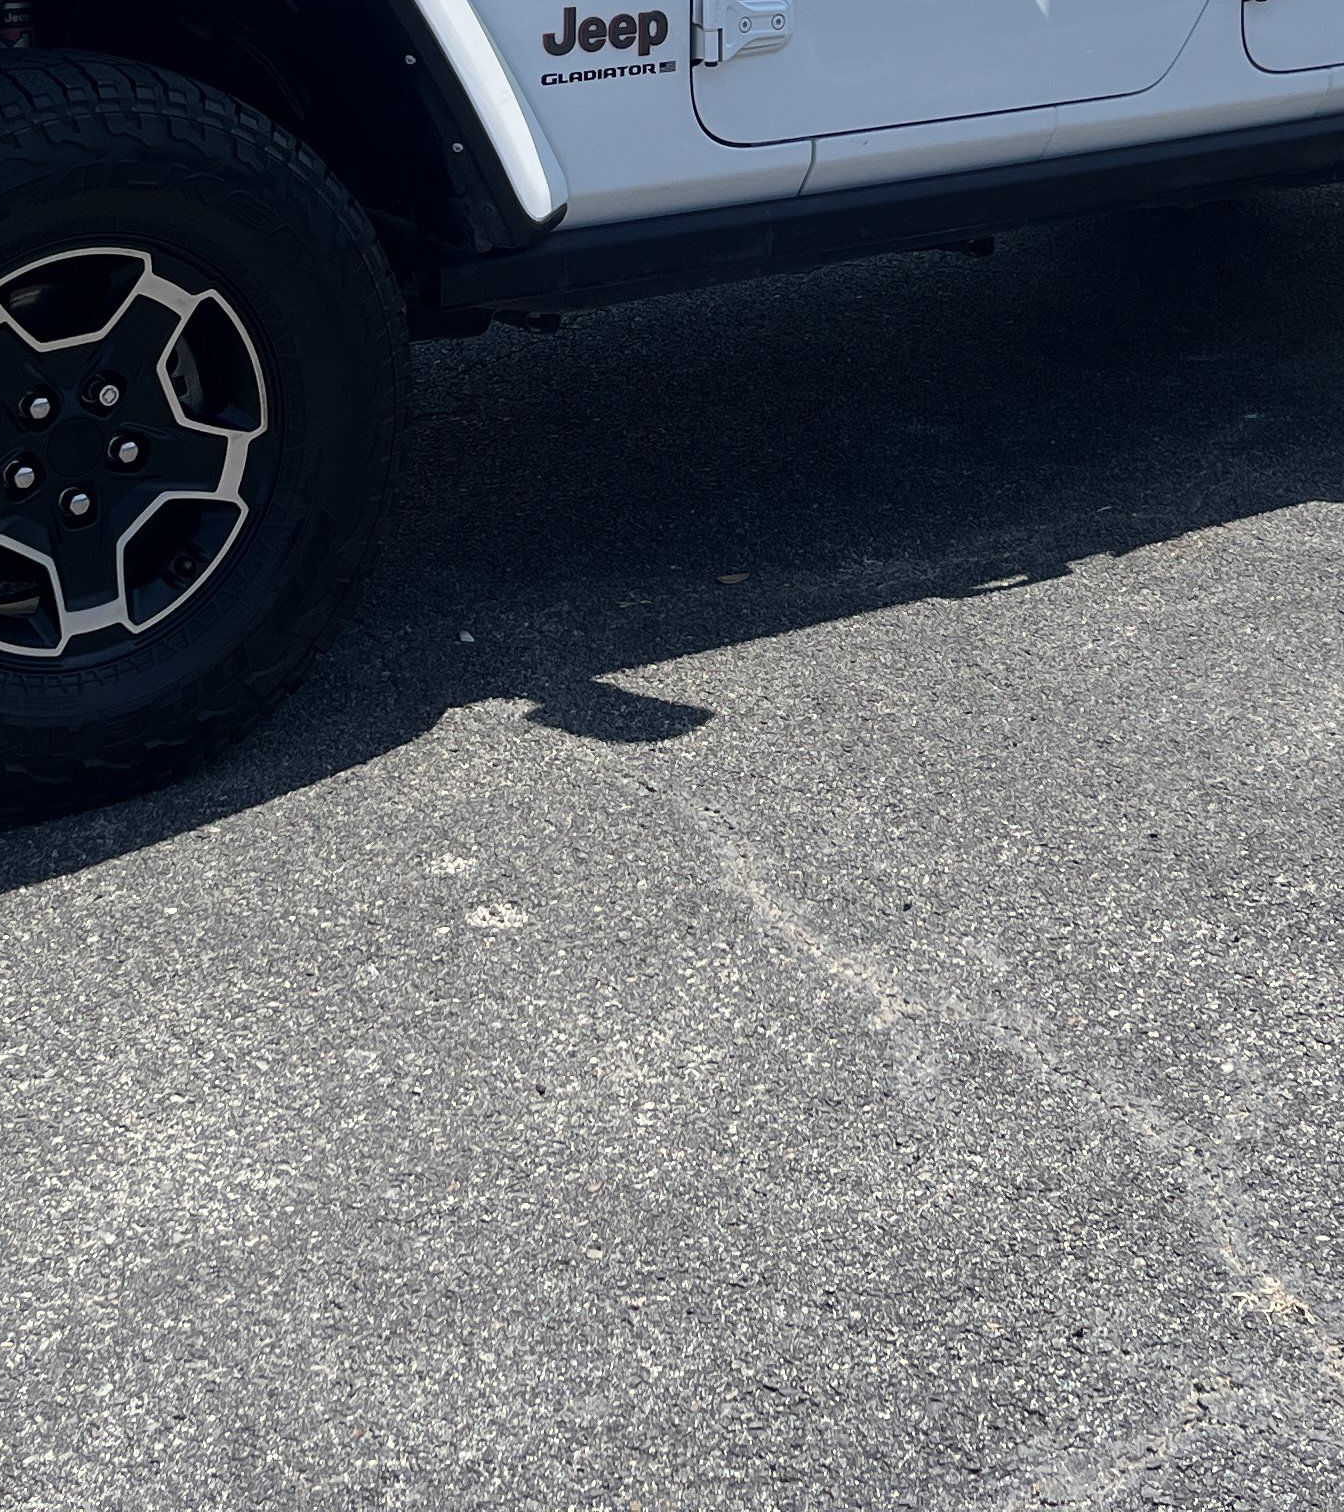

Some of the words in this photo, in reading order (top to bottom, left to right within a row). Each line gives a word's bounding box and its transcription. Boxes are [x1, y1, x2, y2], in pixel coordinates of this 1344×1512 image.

[4, 12, 31, 25] Jeep
[542, 6, 669, 57] Jeep
[540, 63, 657, 86] GLADIATOR
